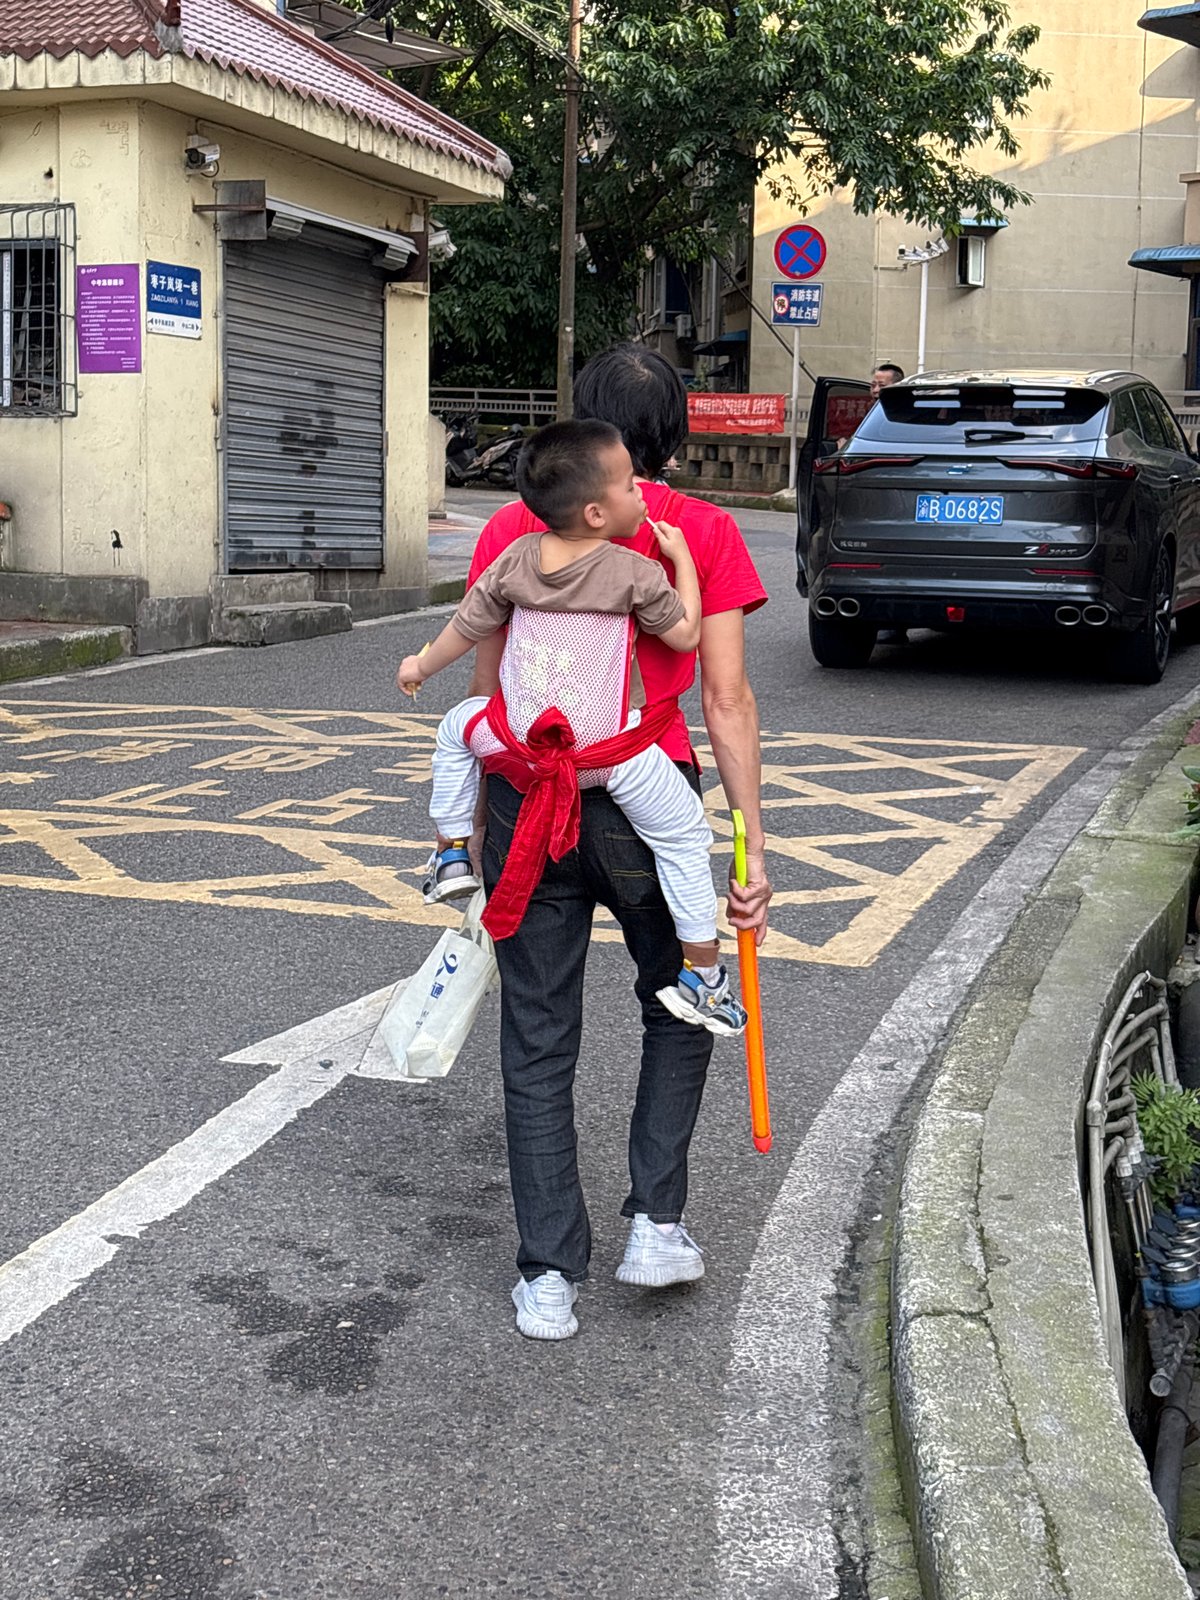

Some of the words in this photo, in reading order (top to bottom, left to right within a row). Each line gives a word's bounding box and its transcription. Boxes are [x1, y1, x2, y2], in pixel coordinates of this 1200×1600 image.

[150, 273, 198, 295] 枣子岚垭一巷
[790, 289, 820, 302] 消防车道
[789, 306, 819, 320] 禁止占用
